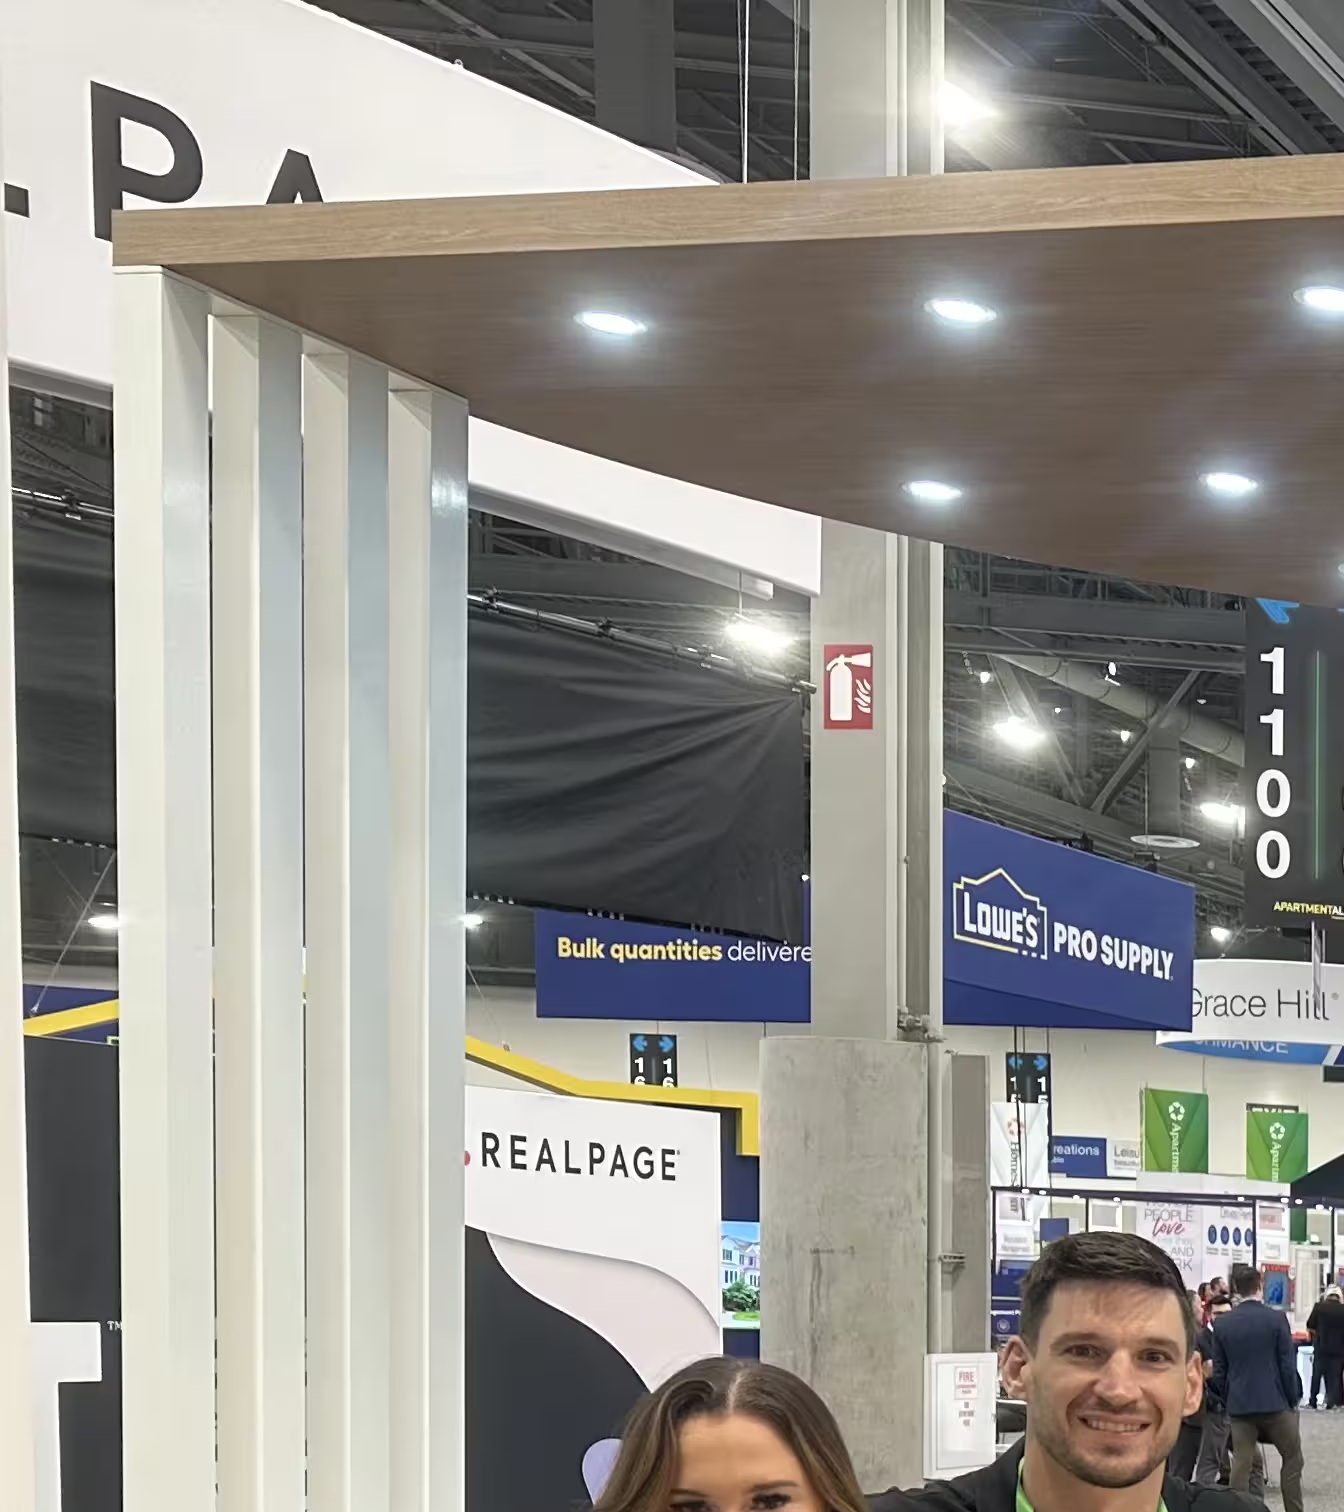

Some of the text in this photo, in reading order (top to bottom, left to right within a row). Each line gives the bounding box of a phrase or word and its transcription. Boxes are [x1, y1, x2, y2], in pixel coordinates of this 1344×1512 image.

[557, 936, 605, 962] Bulk
[610, 936, 723, 967] quantities
[1054, 922, 1097, 961] PRO
[1100, 934, 1174, 981] SUPPLY
[1277, 989, 1330, 1021] Hill
[481, 1131, 678, 1182] REALPAGE
